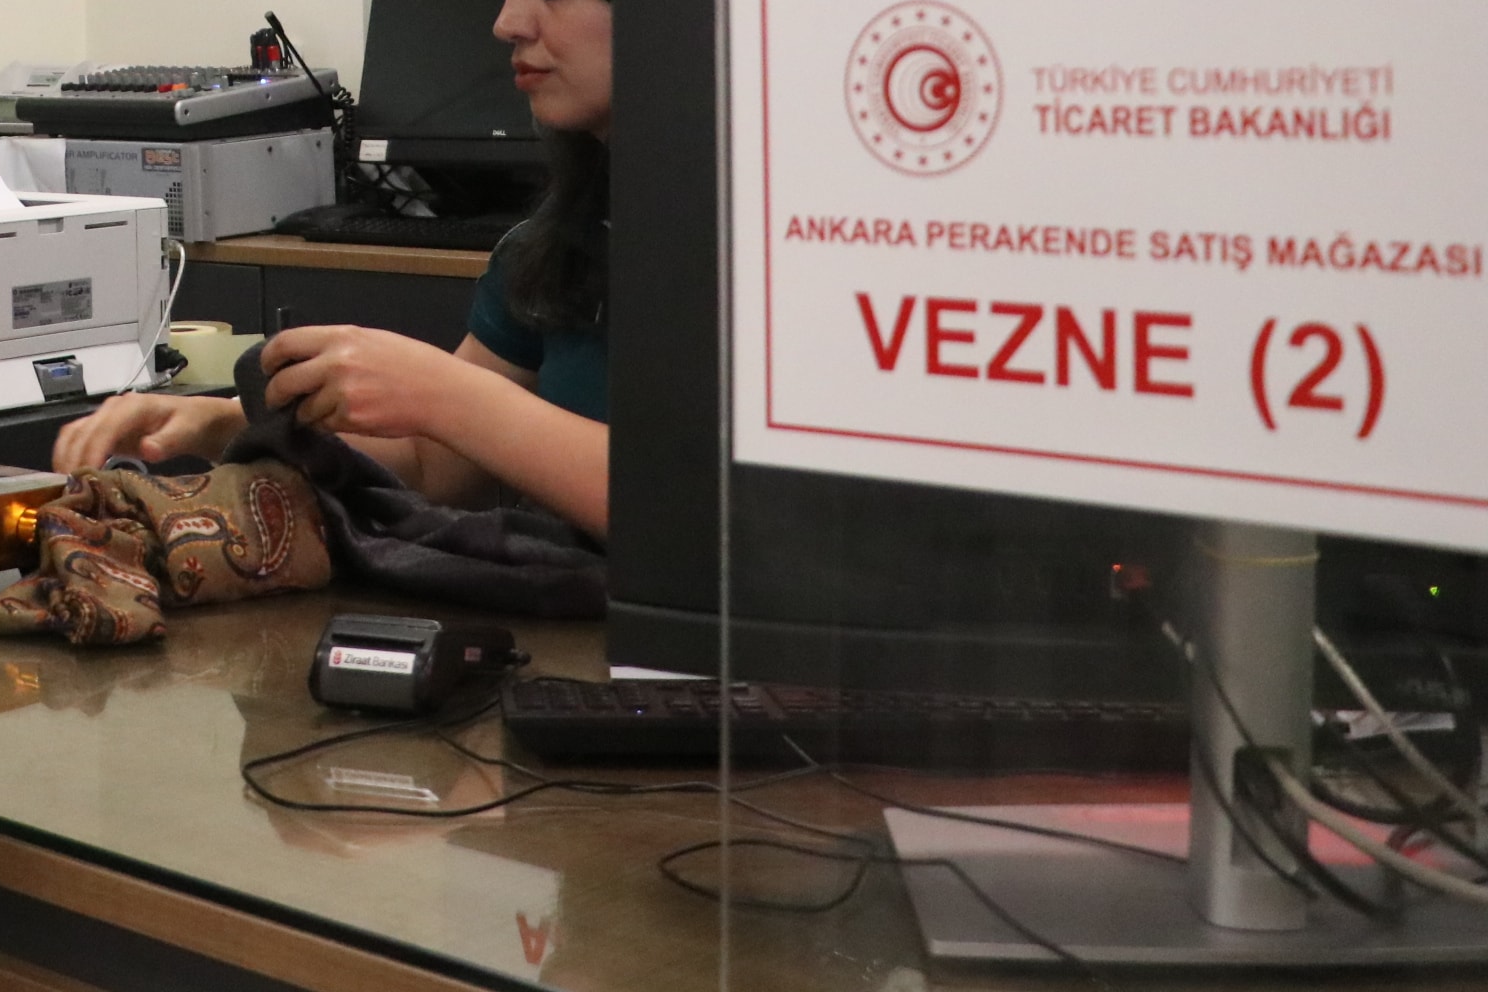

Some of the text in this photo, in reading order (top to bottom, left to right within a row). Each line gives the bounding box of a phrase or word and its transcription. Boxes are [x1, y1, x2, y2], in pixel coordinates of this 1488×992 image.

[1033, 63, 1394, 96] TÜRKİYE CUMHURİYETİ
[1035, 96, 1393, 142] TİCARET BAKANLIĞI
[784, 215, 1484, 279] ANKARA PERAKENDE SATIŞ MAĞAZASI
[855, 291, 1388, 442] VEZNE (2)
[344, 653, 371, 666] Ziraat
